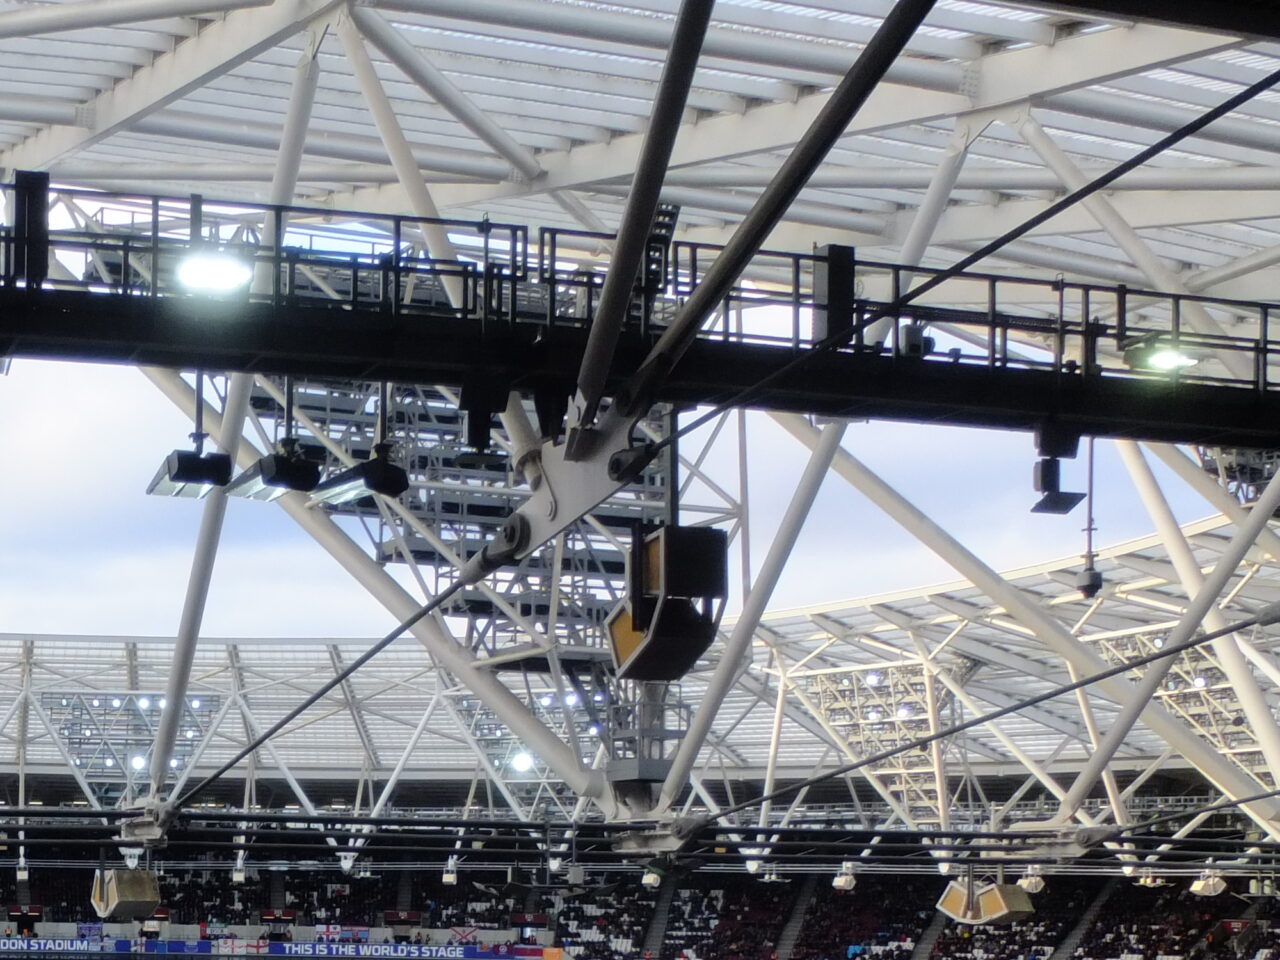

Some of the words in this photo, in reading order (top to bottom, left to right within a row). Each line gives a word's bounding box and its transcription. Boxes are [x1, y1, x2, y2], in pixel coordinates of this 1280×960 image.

[30, 939, 88, 951] STADIUM
[283, 943, 313, 954] THIS
[315, 943, 327, 955] IS
[330, 944, 356, 955] THE
[358, 944, 419, 957] WORLD'S
[421, 946, 464, 958] STAGE
